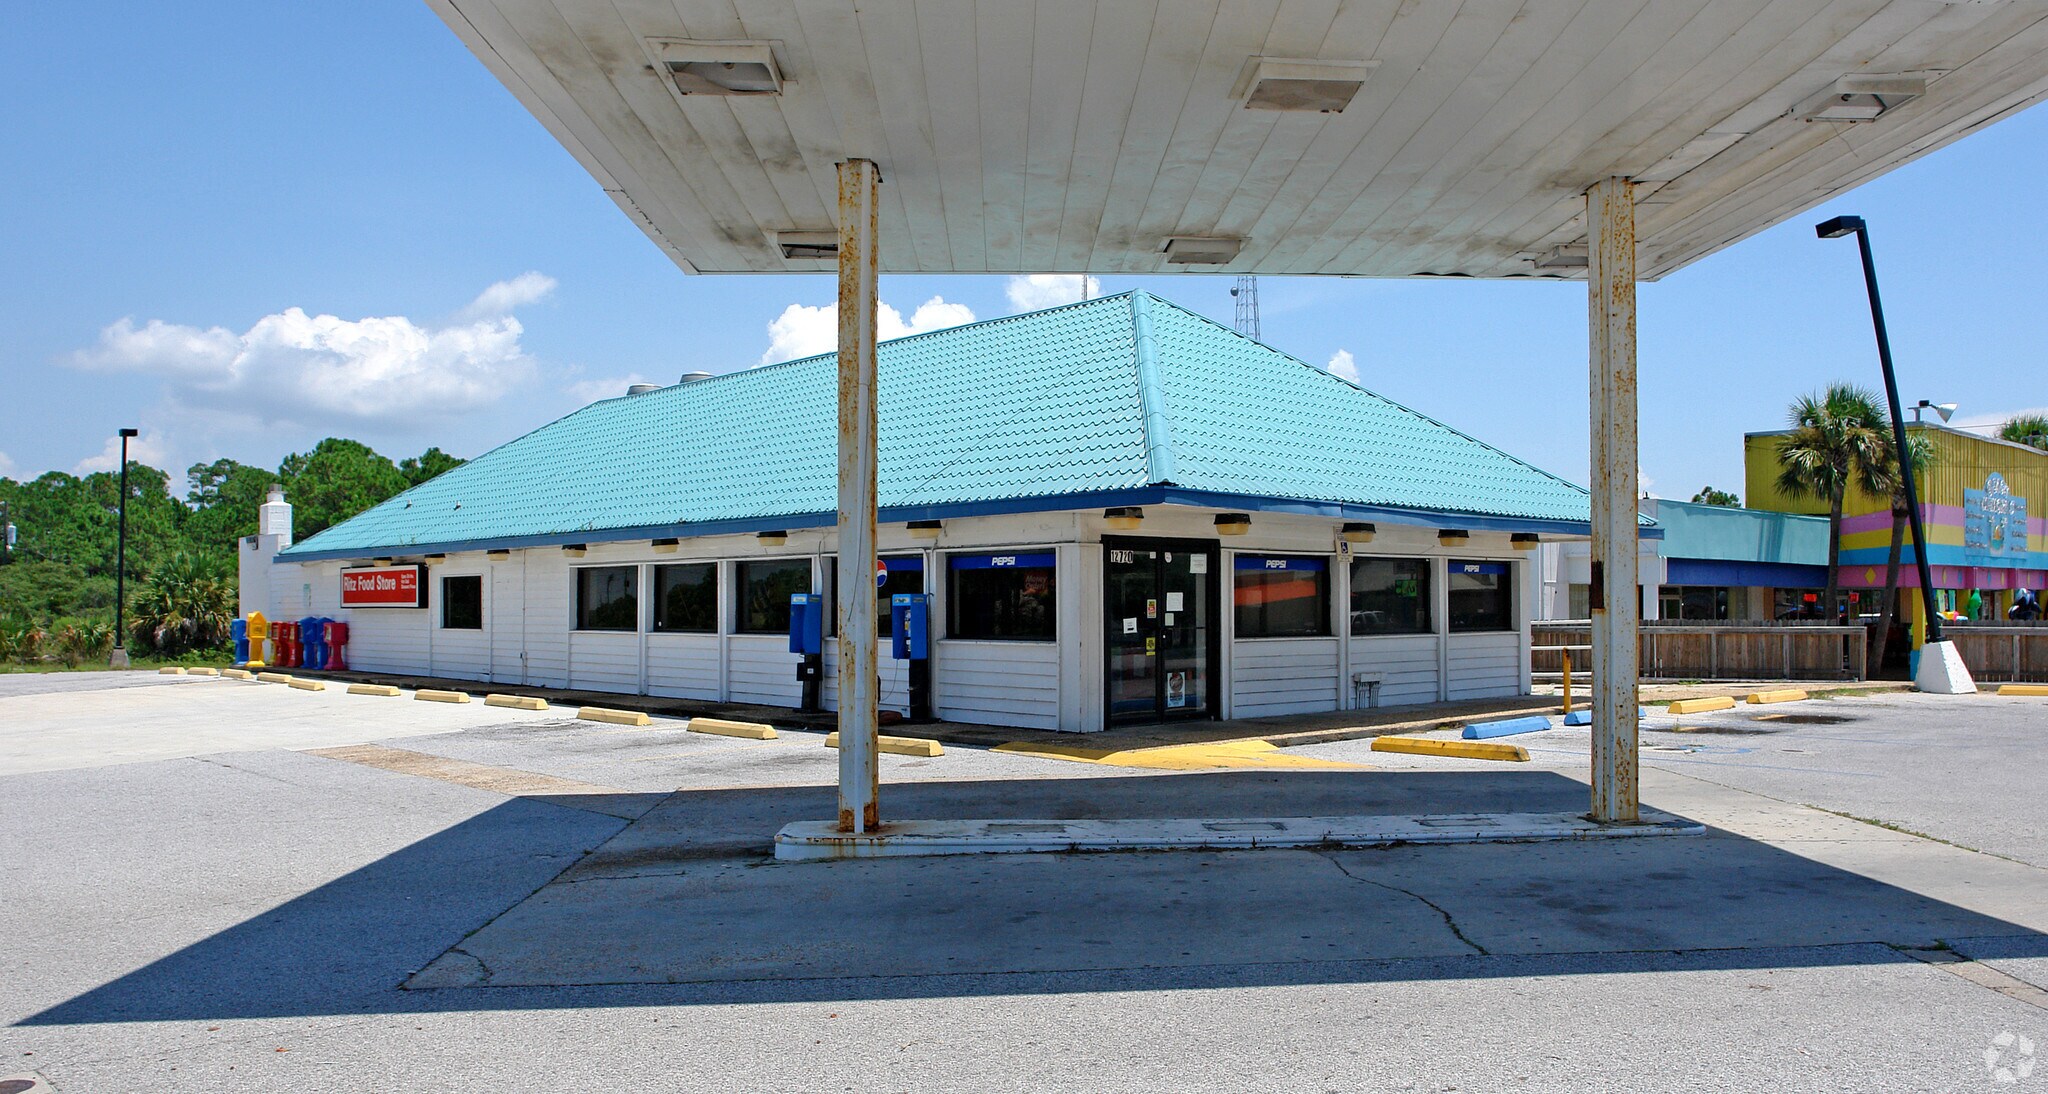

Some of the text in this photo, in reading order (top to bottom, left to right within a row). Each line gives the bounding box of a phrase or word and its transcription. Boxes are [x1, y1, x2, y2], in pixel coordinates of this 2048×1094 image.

[991, 556, 1016, 566] PEPSI
[1110, 550, 1133, 563] 12720
[1265, 559, 1287, 568] PEPSI
[1463, 564, 1480, 573] PEPSI
[343, 574, 397, 591] Ritz Food Store
